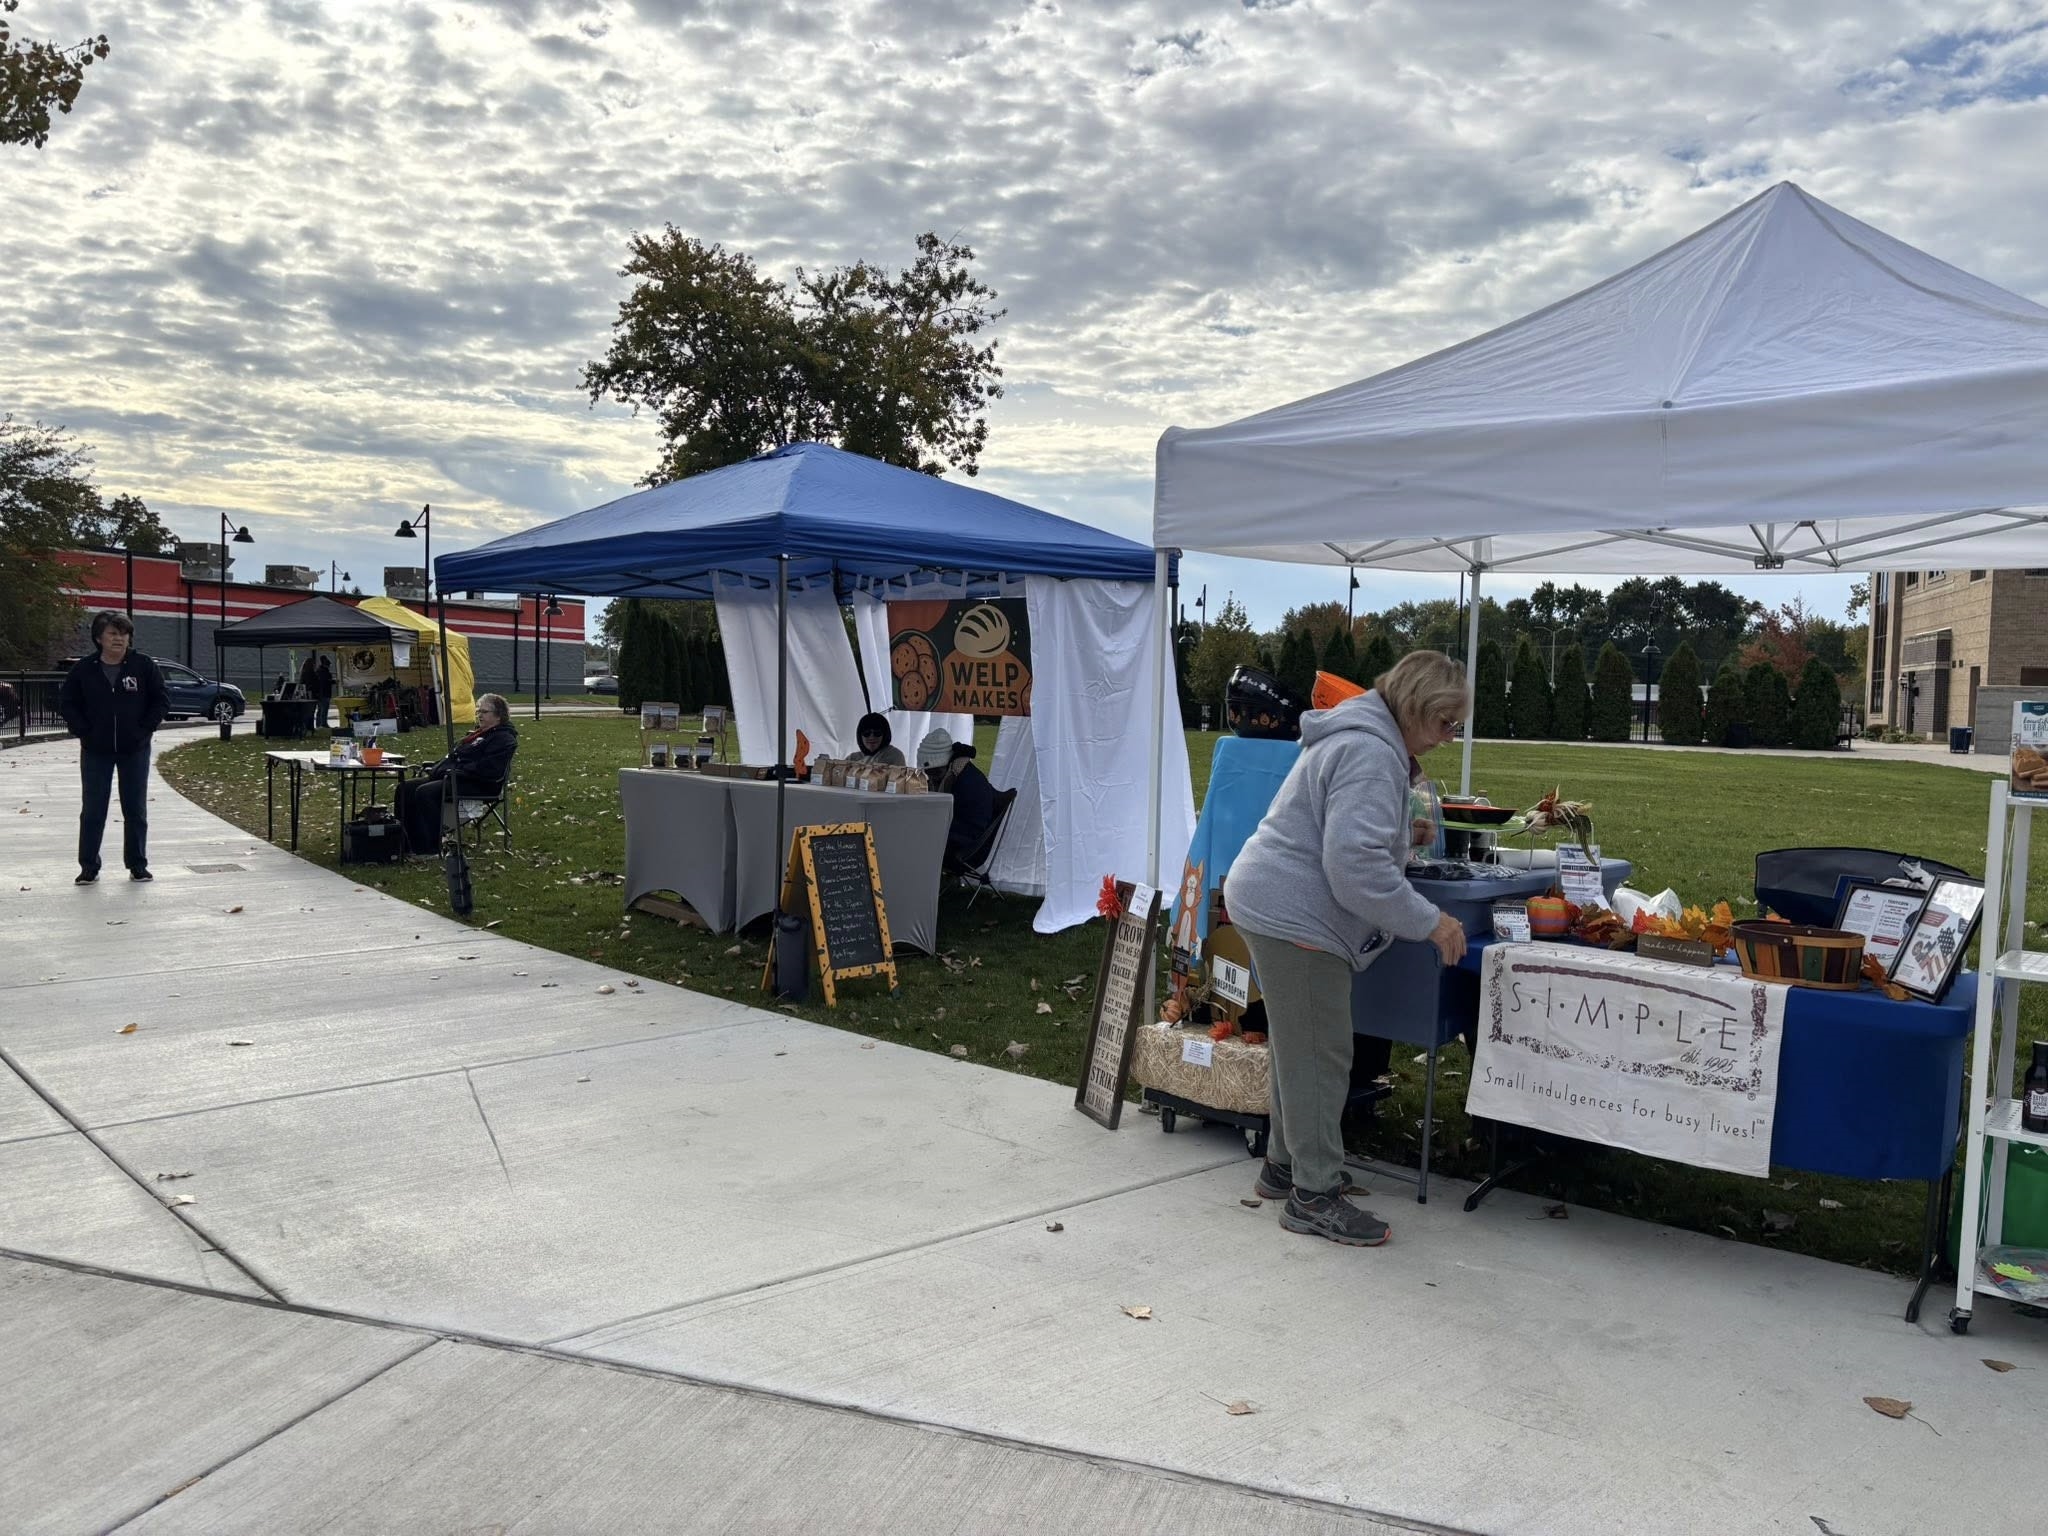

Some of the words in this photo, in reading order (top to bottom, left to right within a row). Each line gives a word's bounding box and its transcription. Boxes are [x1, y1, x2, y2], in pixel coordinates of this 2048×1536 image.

[950, 662, 1019, 687] WELP
[953, 689, 1018, 709] MAKES
[1118, 921, 1146, 947] CROW
[1641, 941, 1665, 950] make
[1677, 944, 1708, 958] happen
[1225, 965, 1236, 984] NO
[1704, 1056, 1737, 1073] 1995
[1484, 1066, 1525, 1090] Small
[1532, 1080, 1623, 1113] indulgences
[1632, 1099, 1656, 1119] for
[1665, 1104, 1701, 1133] busy
